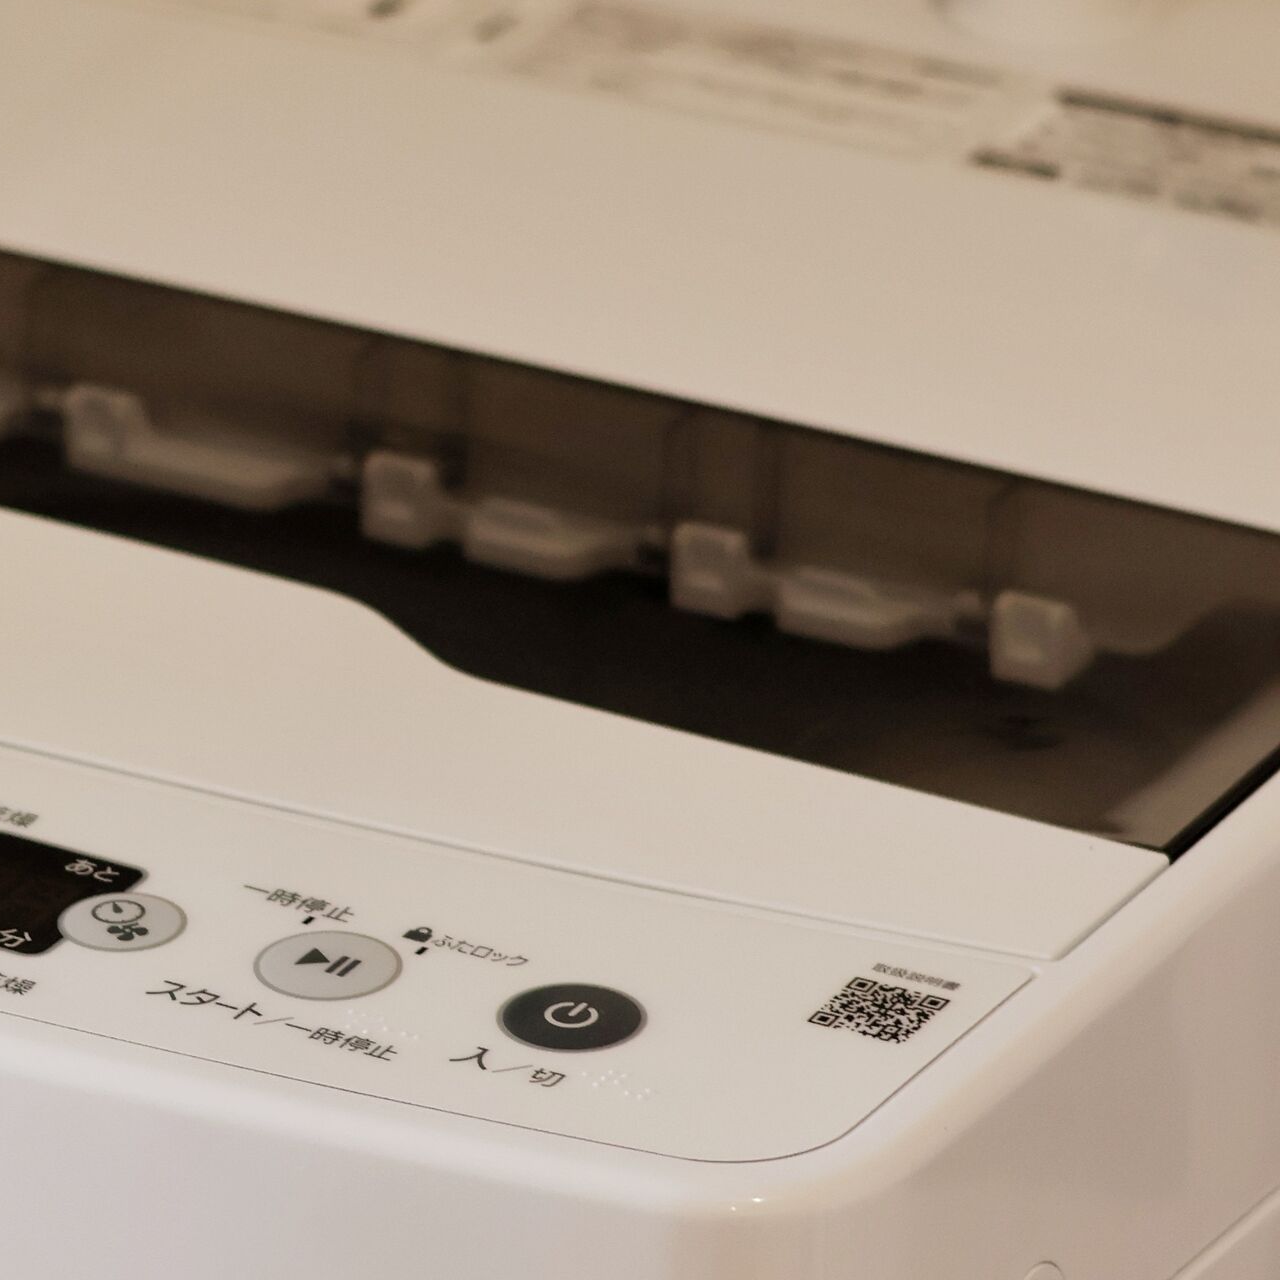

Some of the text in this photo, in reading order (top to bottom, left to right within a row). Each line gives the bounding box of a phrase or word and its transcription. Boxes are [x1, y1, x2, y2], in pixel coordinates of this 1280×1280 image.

[64, 858, 120, 883] あと
[243, 883, 355, 923] 一時停止
[431, 934, 530, 967] ふたロック
